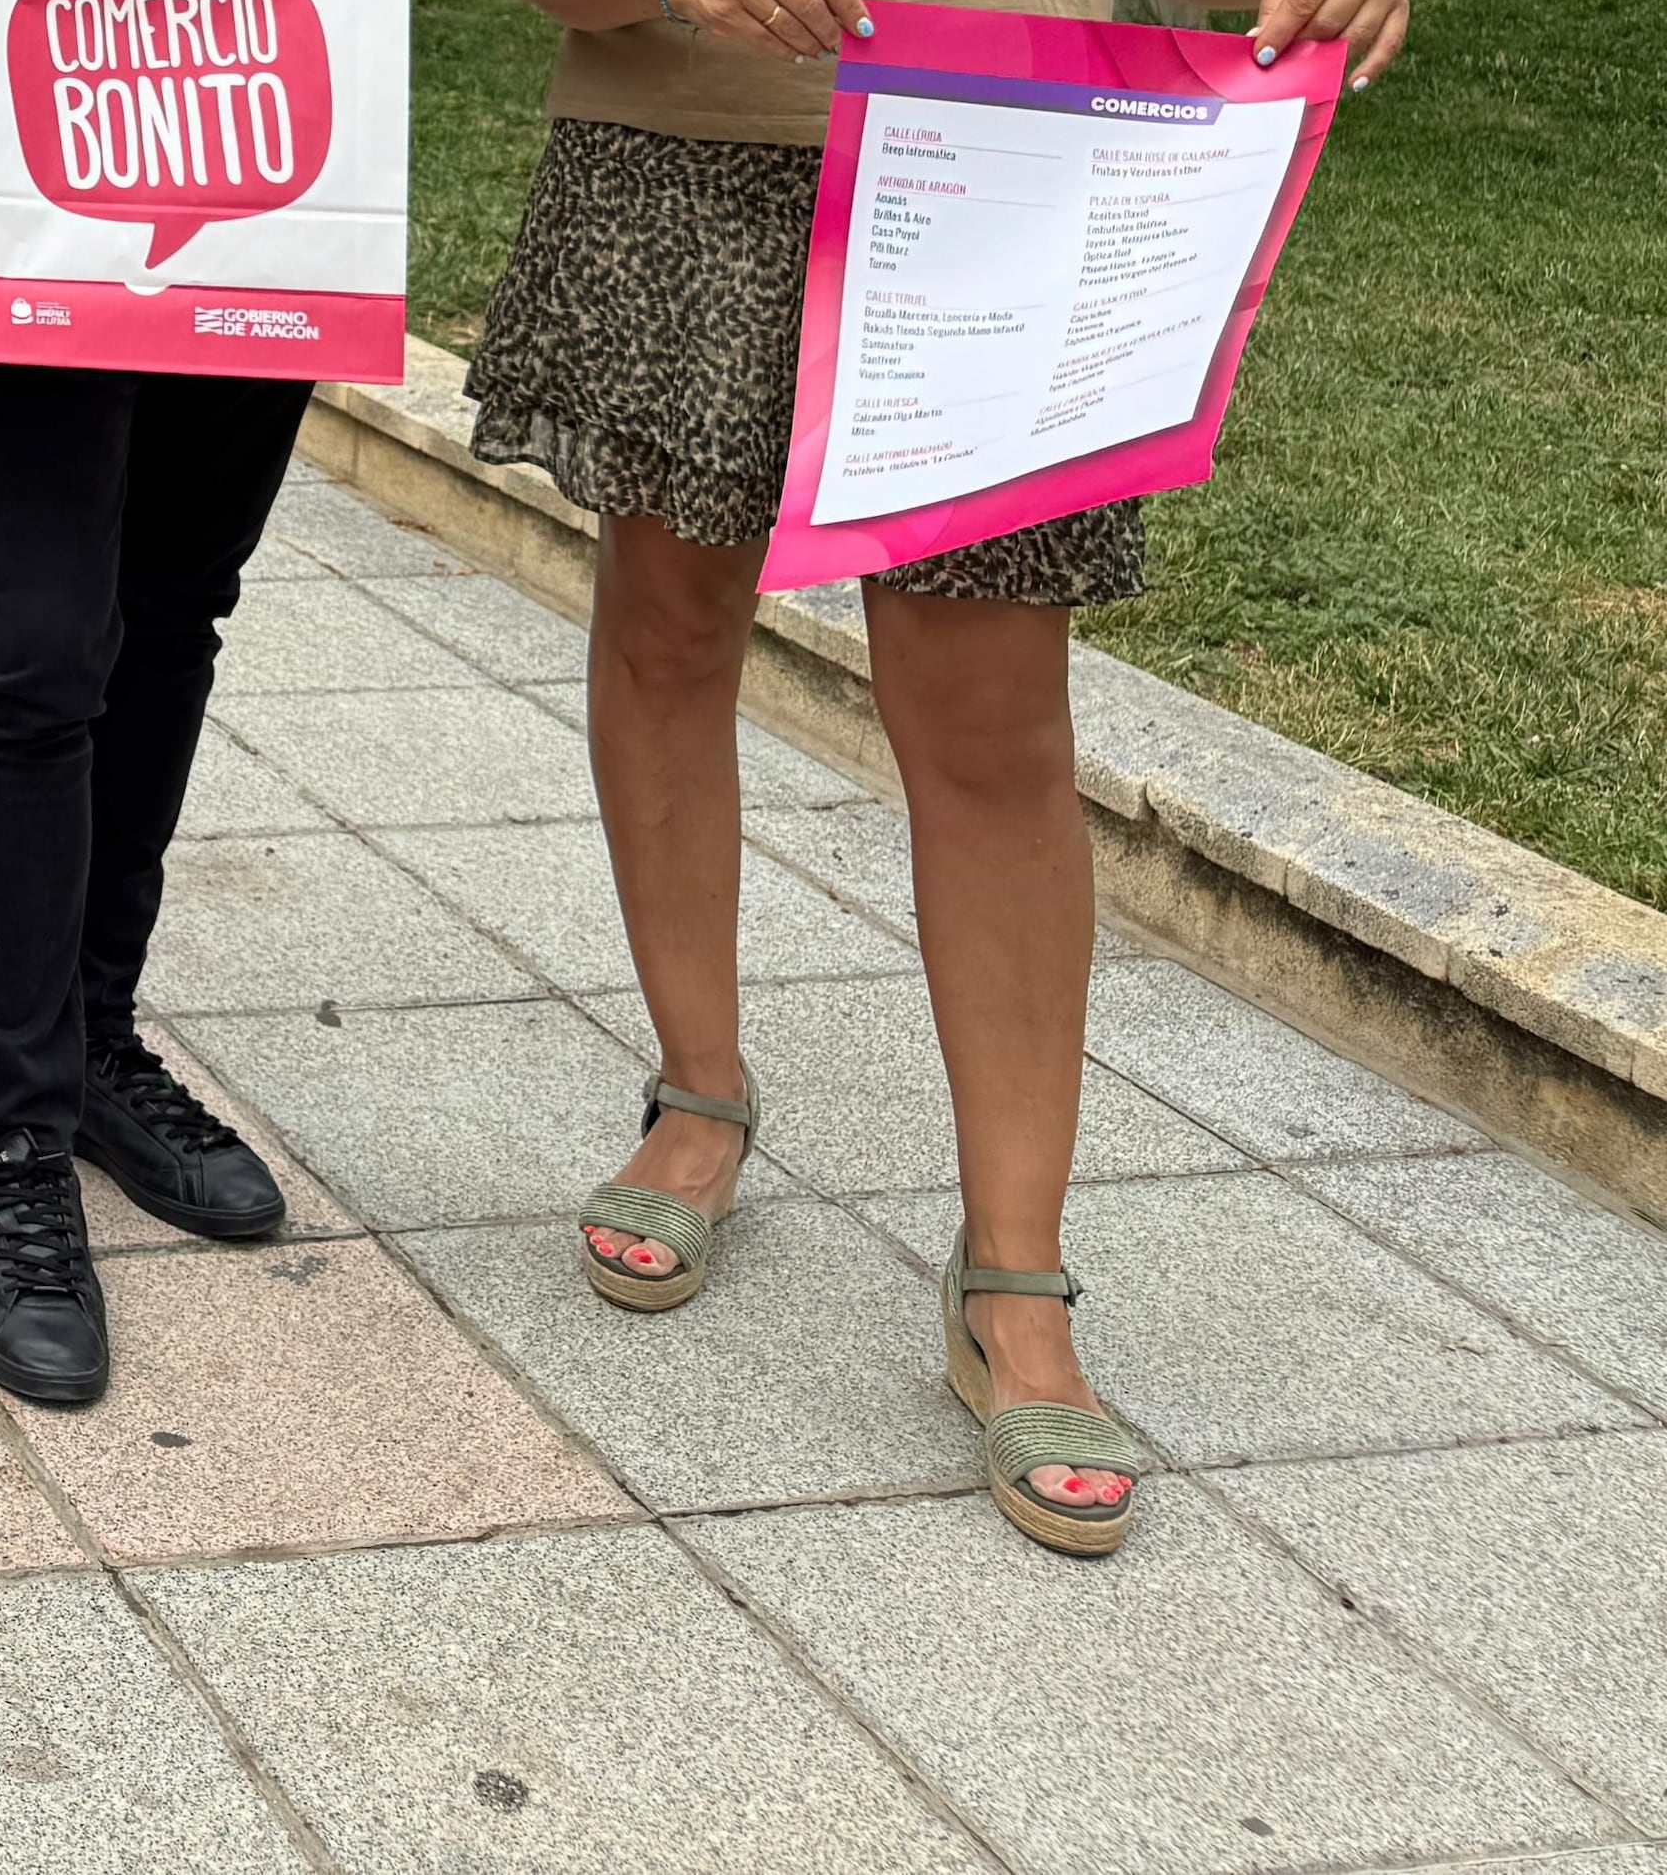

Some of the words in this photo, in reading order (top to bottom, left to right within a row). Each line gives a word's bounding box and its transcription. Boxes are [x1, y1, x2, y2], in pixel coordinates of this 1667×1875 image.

[1091, 96, 1208, 120] COMERCIOS
[51, 71, 296, 192] BONITO
[883, 126, 910, 140] CALLE
[1092, 148, 1121, 162] CALLE
[1122, 150, 1142, 162] SAN
[915, 178, 926, 191] DE
[871, 225, 894, 238] Casa
[865, 290, 893, 304] CALLE
[223, 308, 308, 325] GOBIERNO
[223, 323, 246, 337] DE
[249, 324, 320, 341] ARAGON
